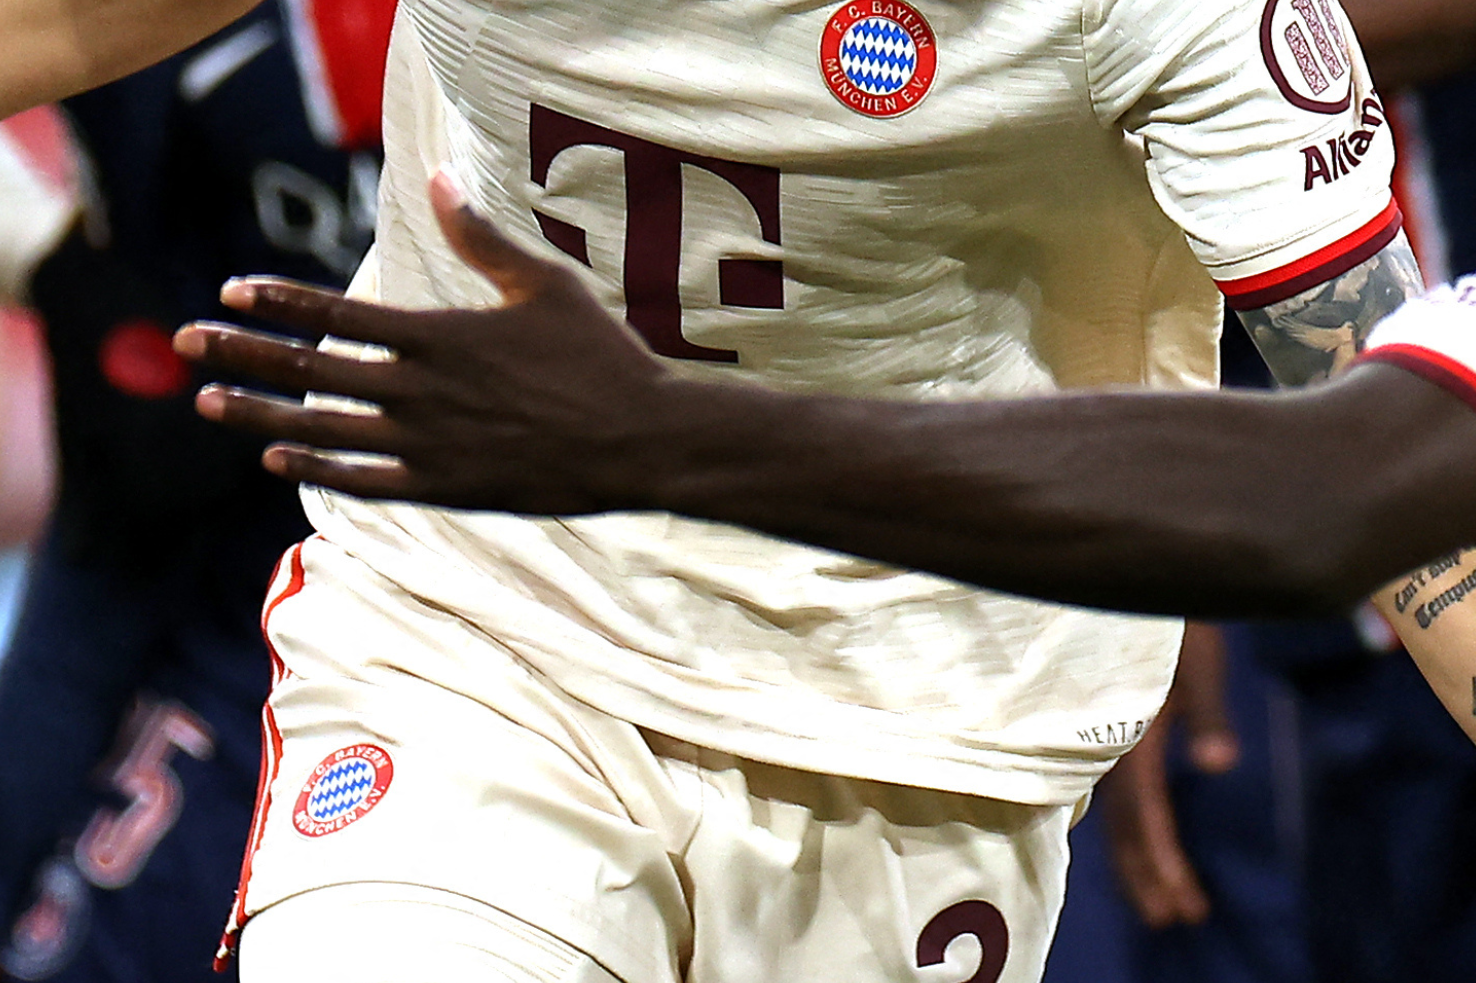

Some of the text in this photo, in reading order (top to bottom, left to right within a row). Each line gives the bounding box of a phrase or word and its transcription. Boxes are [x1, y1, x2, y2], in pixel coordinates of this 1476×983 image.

[871, 0, 931, 50] BAYERN
[825, 57, 898, 112] MÜNCHEN
[1299, 88, 1385, 192] Allian
